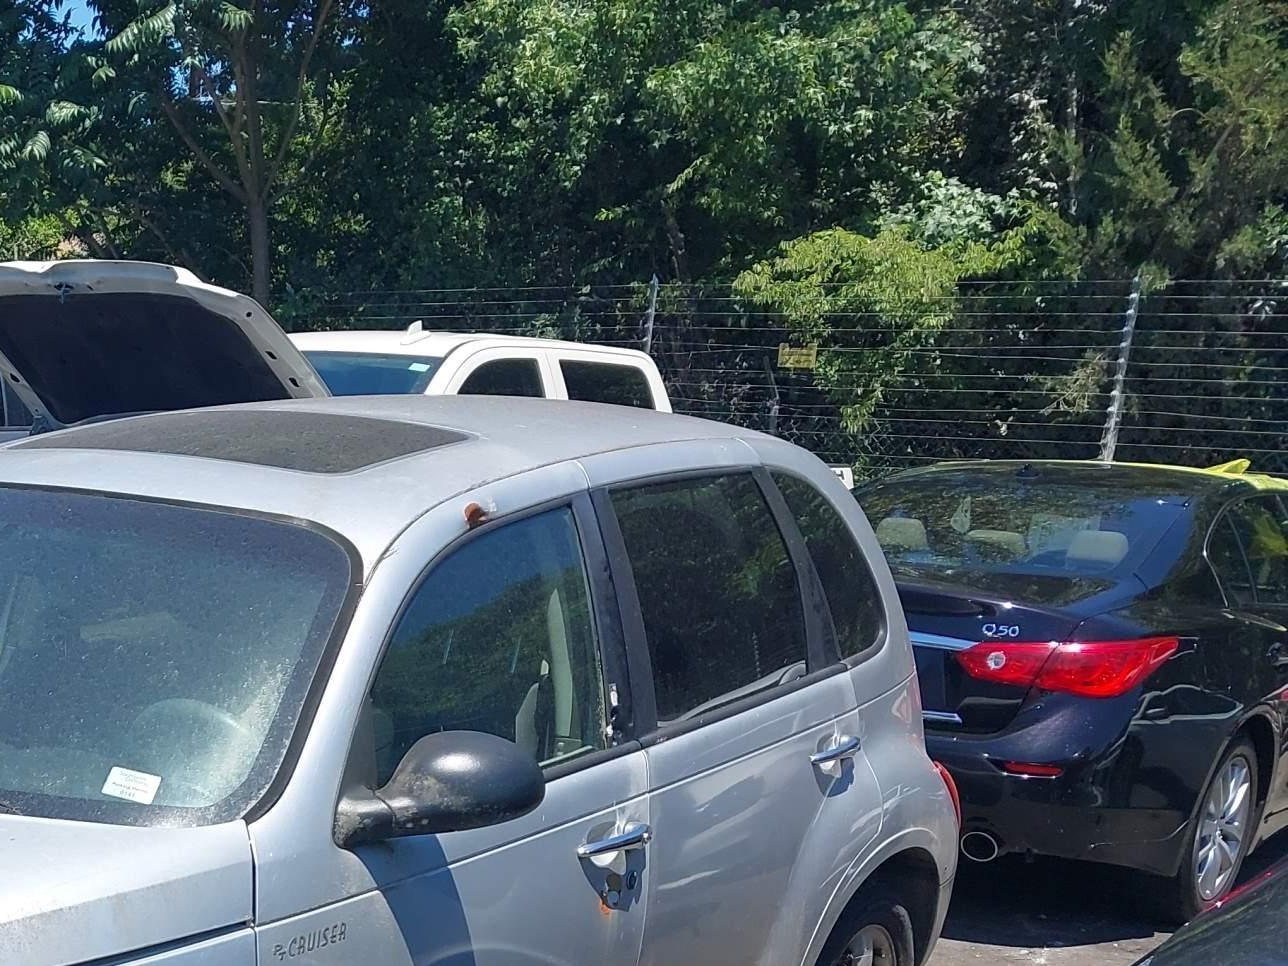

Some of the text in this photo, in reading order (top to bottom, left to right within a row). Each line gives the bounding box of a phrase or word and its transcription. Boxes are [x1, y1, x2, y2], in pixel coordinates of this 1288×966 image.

[982, 623, 1020, 638] Q50
[272, 921, 347, 961] PT CRUISER
